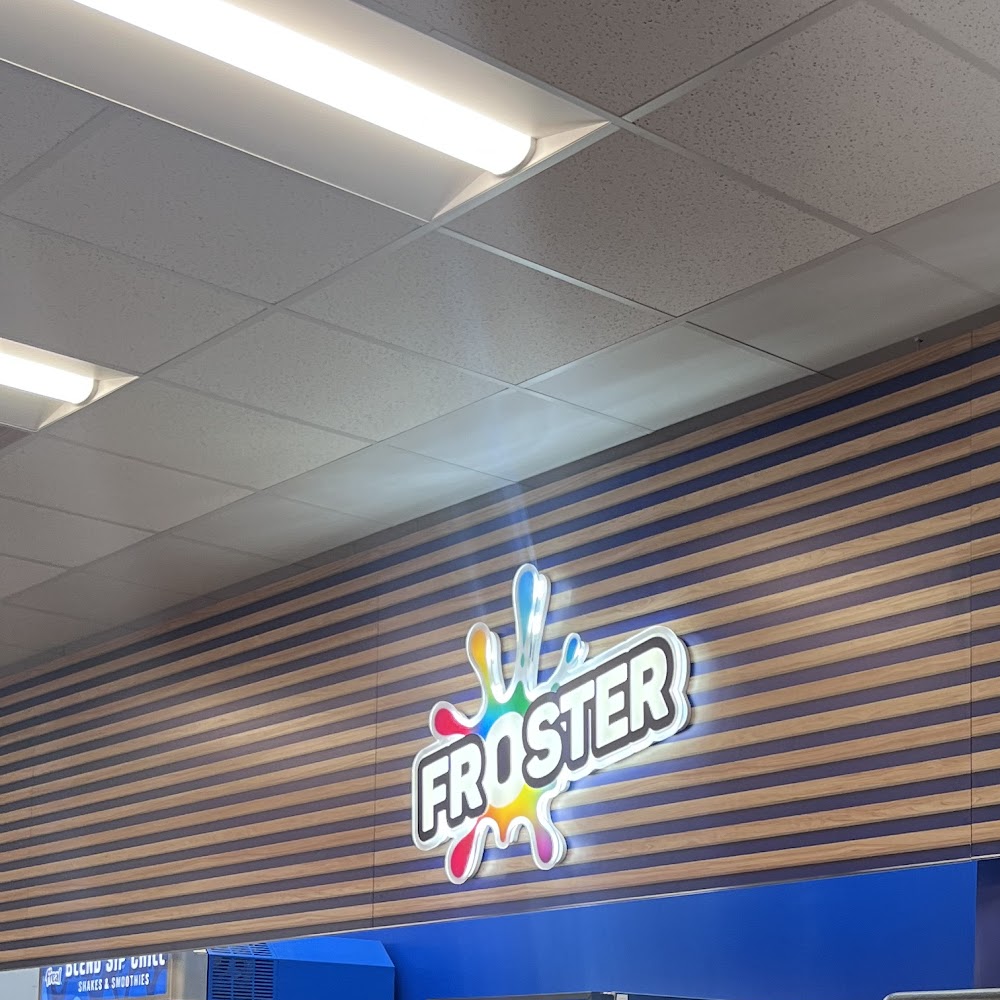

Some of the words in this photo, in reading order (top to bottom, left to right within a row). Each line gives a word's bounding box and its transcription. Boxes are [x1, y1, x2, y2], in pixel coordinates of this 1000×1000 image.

[418, 640, 673, 838] FROSTER
[78, 978, 102, 992] SHAKES
[111, 973, 150, 988] SMOOTHIES
